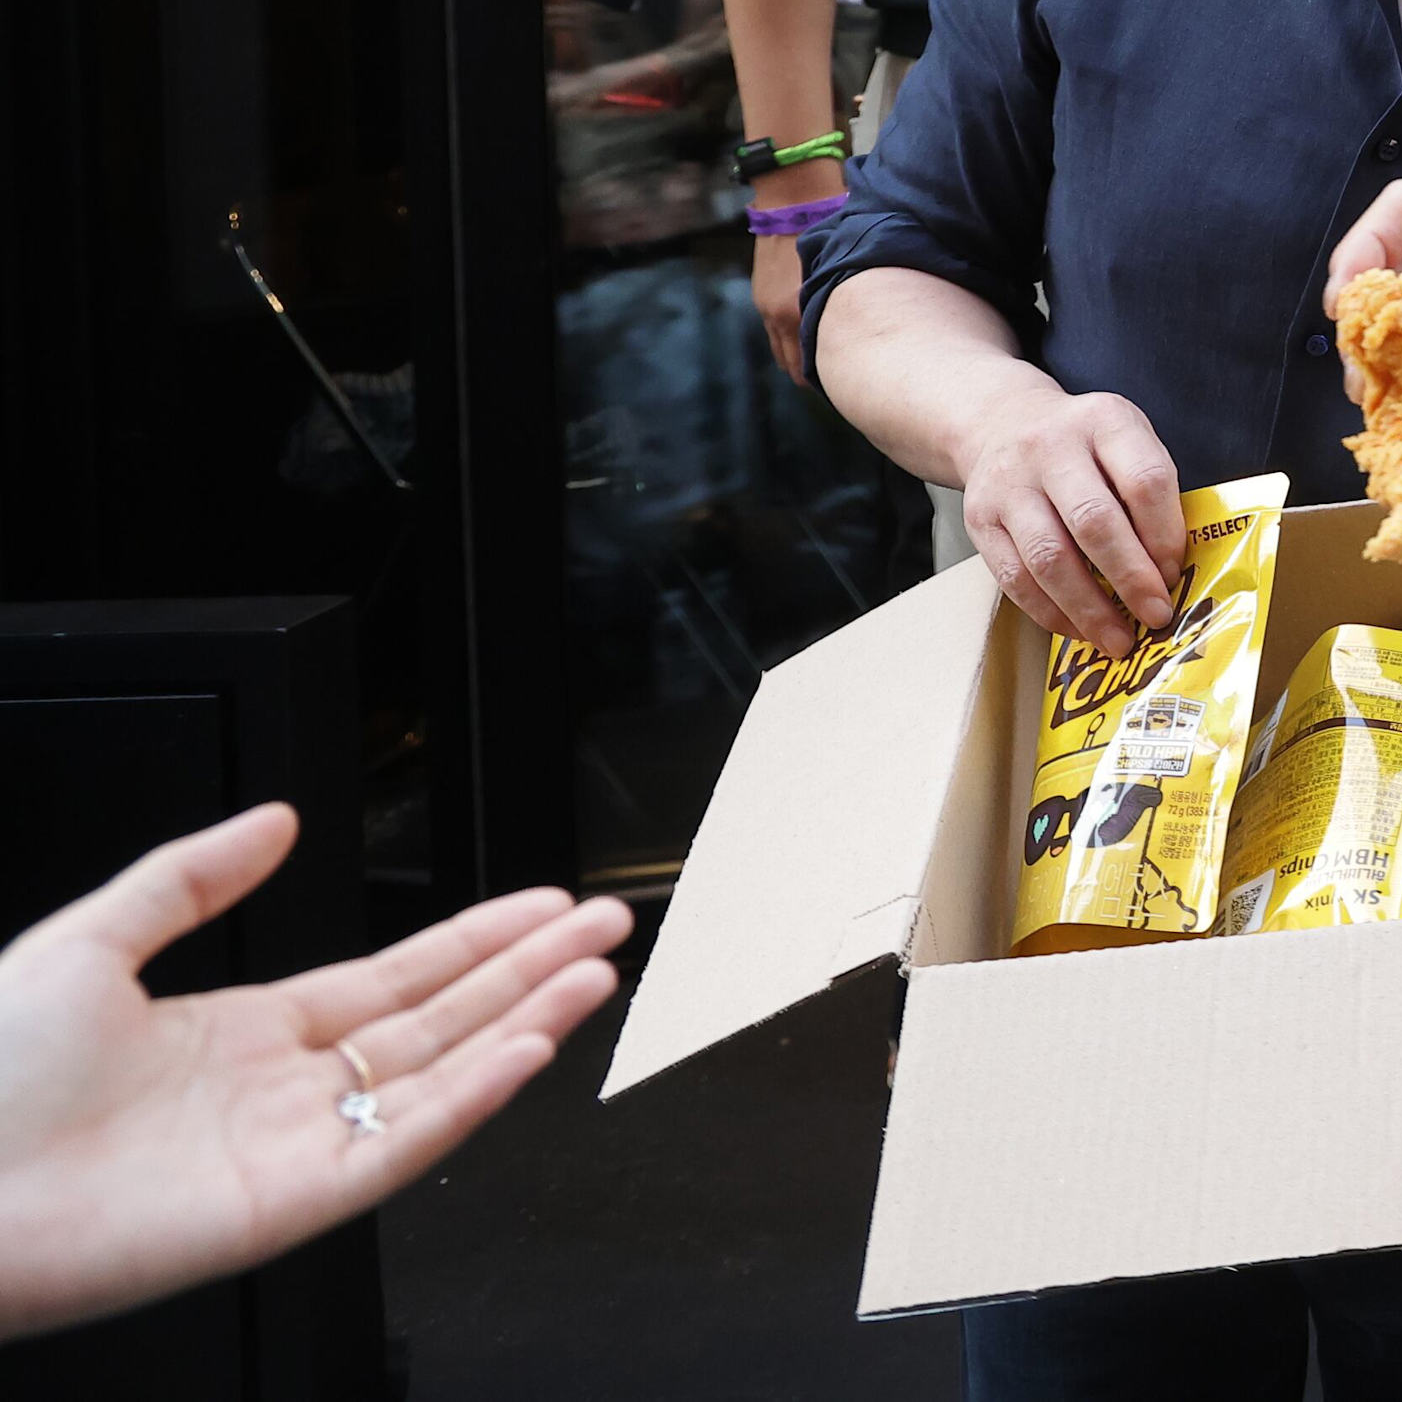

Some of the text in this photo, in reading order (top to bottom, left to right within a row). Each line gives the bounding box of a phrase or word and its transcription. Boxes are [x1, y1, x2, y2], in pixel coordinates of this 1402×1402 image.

[1190, 514, 1251, 545] 7-SELECT
[1056, 628, 1204, 720] Chips
[1333, 847, 1390, 868] HBM
[1353, 887, 1383, 905] SK
